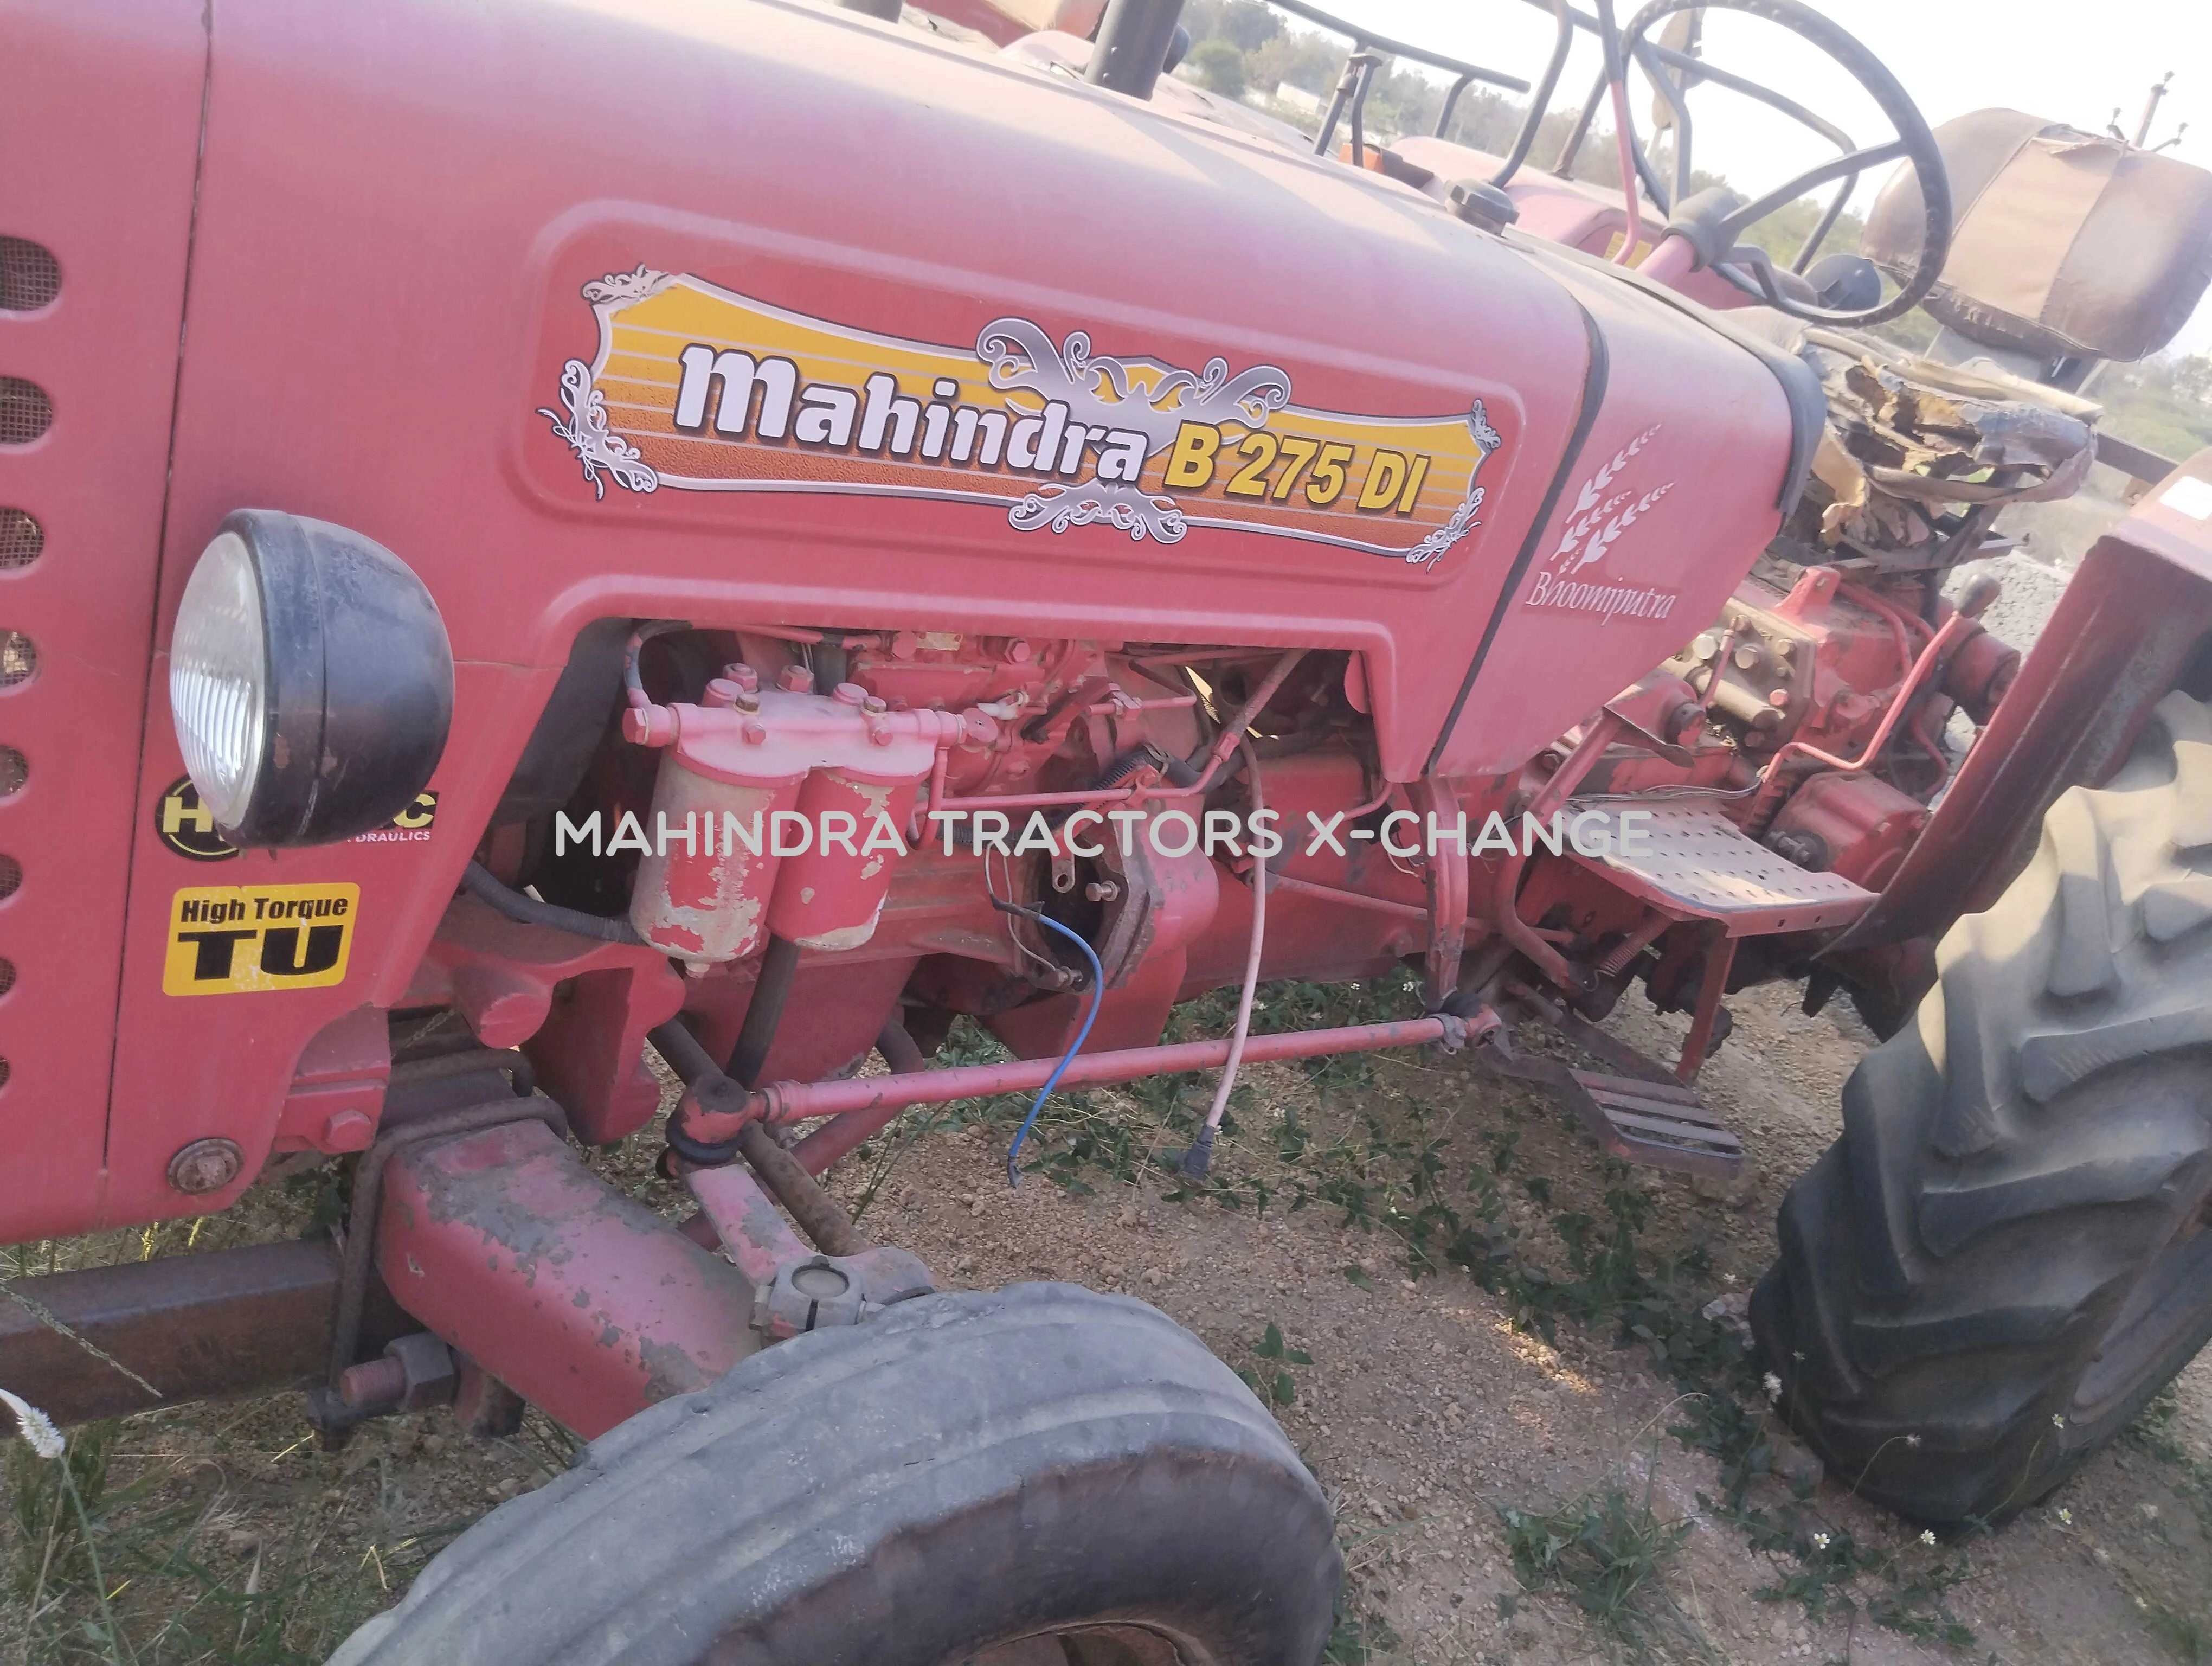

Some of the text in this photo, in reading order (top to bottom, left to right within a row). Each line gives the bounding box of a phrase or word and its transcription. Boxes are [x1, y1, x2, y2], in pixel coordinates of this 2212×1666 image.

[1162, 419, 1222, 489] B
[1224, 430, 1356, 507] 275
[1356, 448, 1431, 516] DI
[1525, 572, 1676, 626] Bhoomiputra
[181, 896, 349, 923] High Torque
[178, 925, 344, 981] TU
